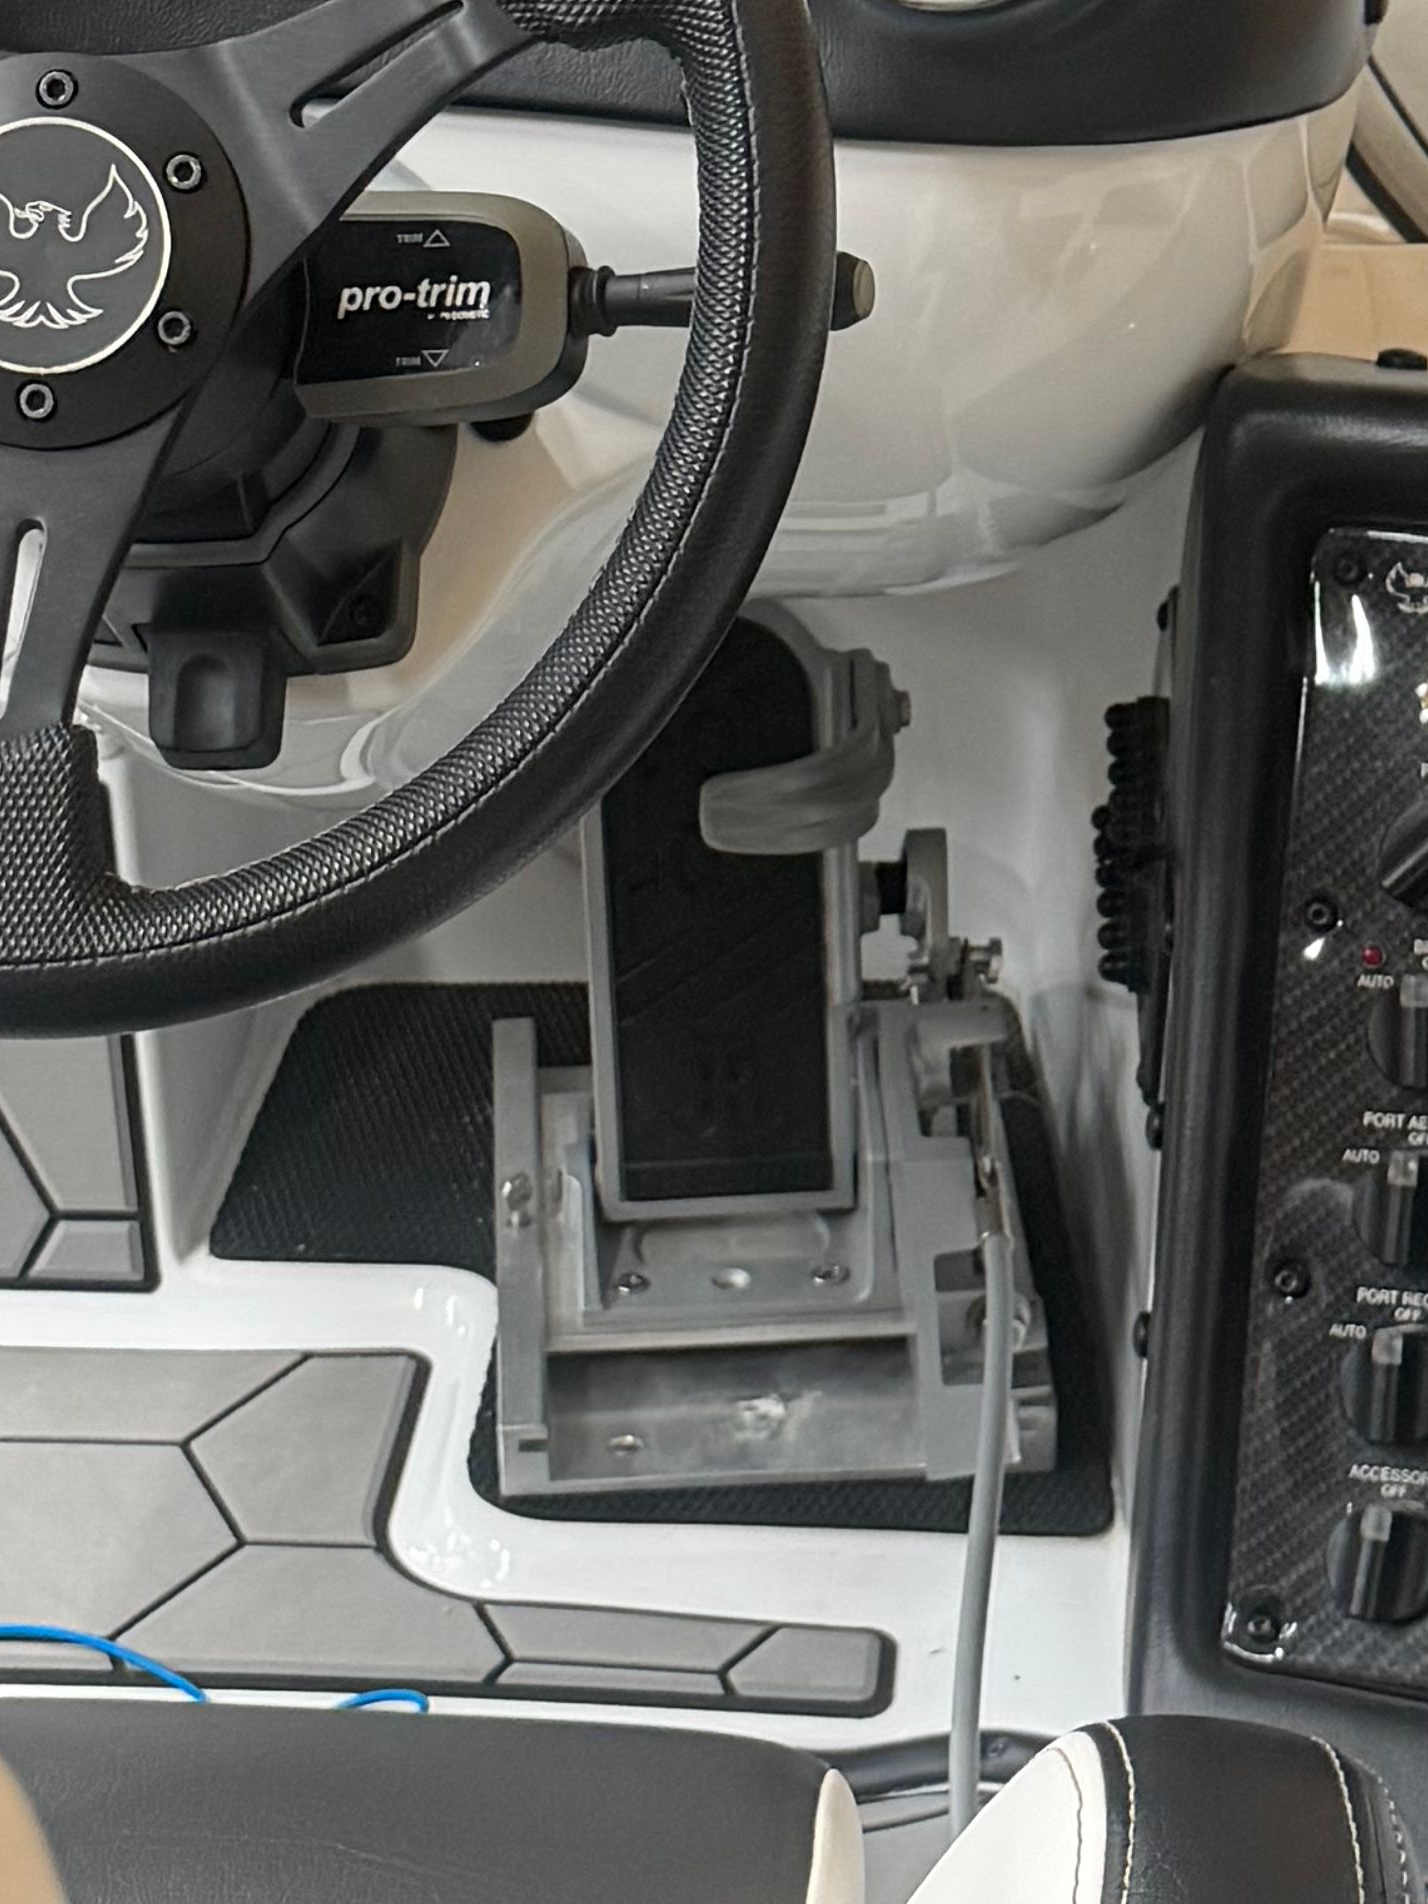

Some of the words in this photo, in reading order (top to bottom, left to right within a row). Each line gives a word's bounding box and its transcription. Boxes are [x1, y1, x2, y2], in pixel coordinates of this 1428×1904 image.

[336, 274, 492, 320] pro-trim
[1356, 973, 1396, 991] AUTO
[1362, 1110, 1406, 1130] PORT
[1341, 1148, 1381, 1165] AUTO
[1356, 1285, 1399, 1307] PORT
[1393, 1307, 1423, 1323] OFF
[1328, 1323, 1368, 1340] AUTO
[1380, 1482, 1408, 1498] OFF
